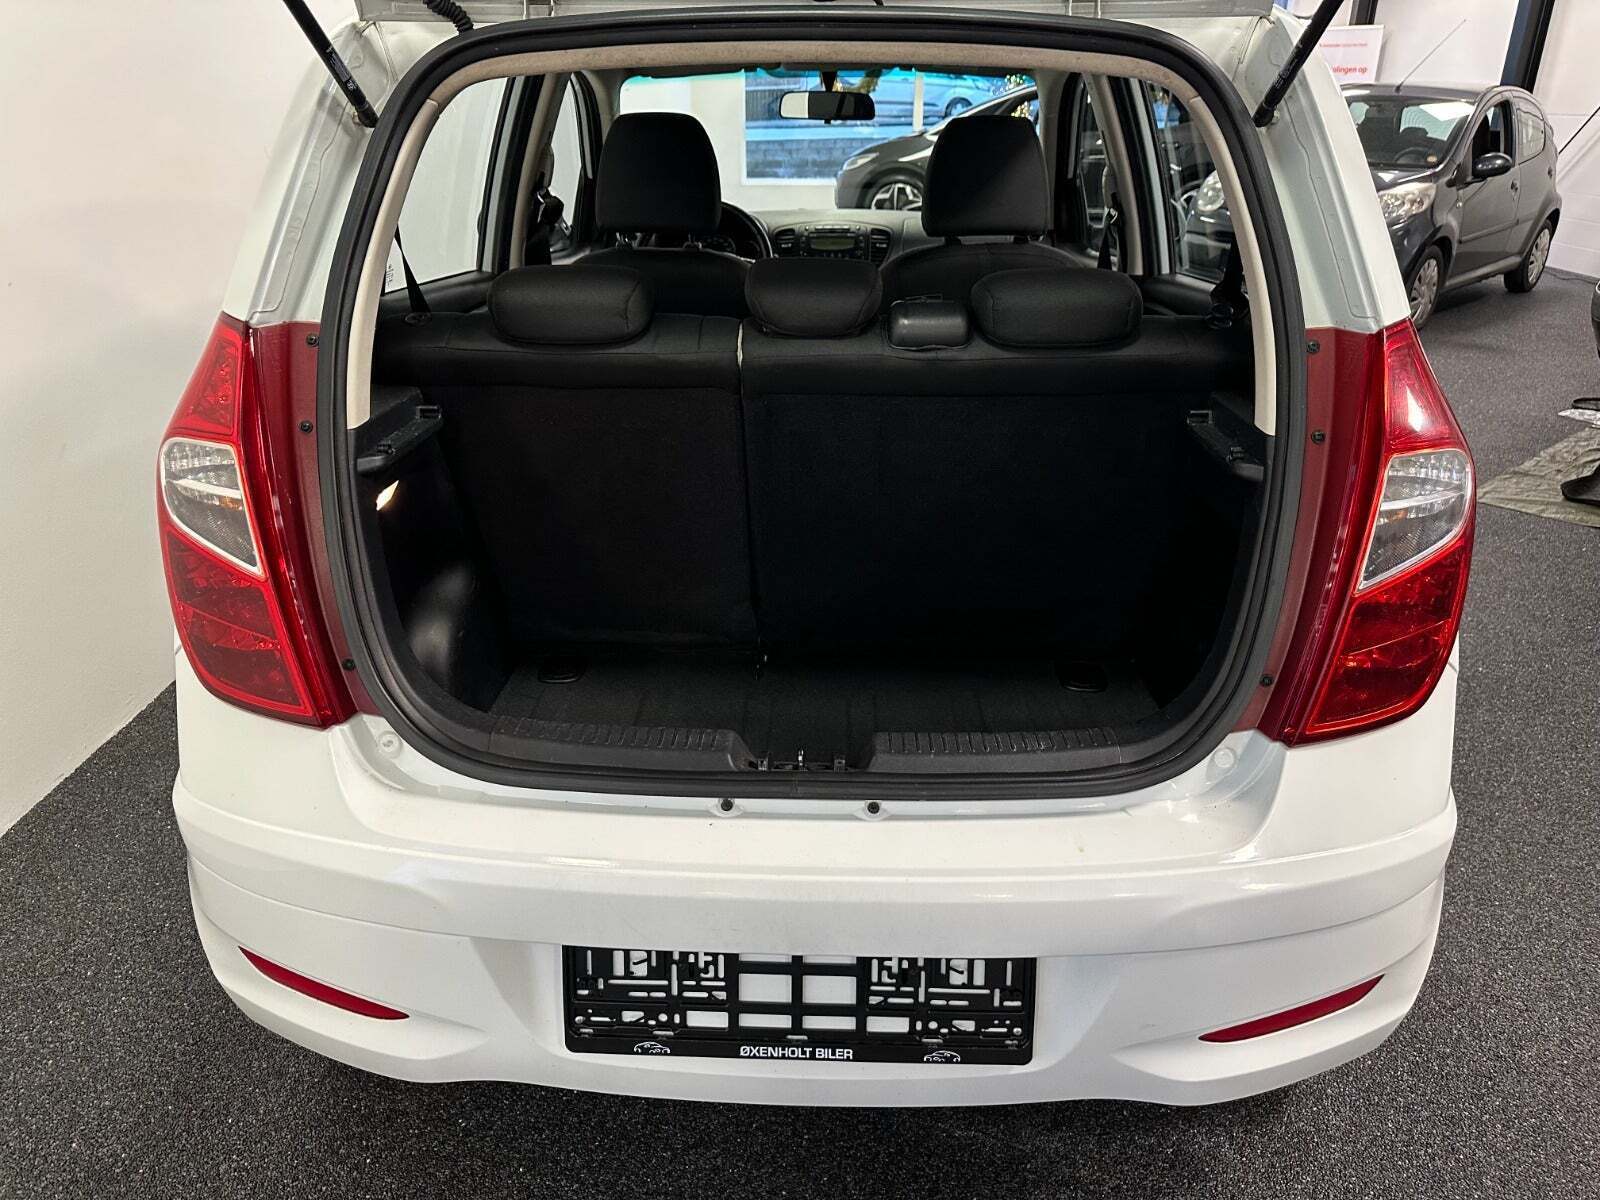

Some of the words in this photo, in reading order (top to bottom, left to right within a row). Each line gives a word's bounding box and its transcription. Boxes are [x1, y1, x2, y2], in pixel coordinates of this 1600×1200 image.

[1358, 66, 1368, 75] op
[740, 1045, 812, 1058] ØXENHOLT
[815, 1047, 853, 1060] BILER
